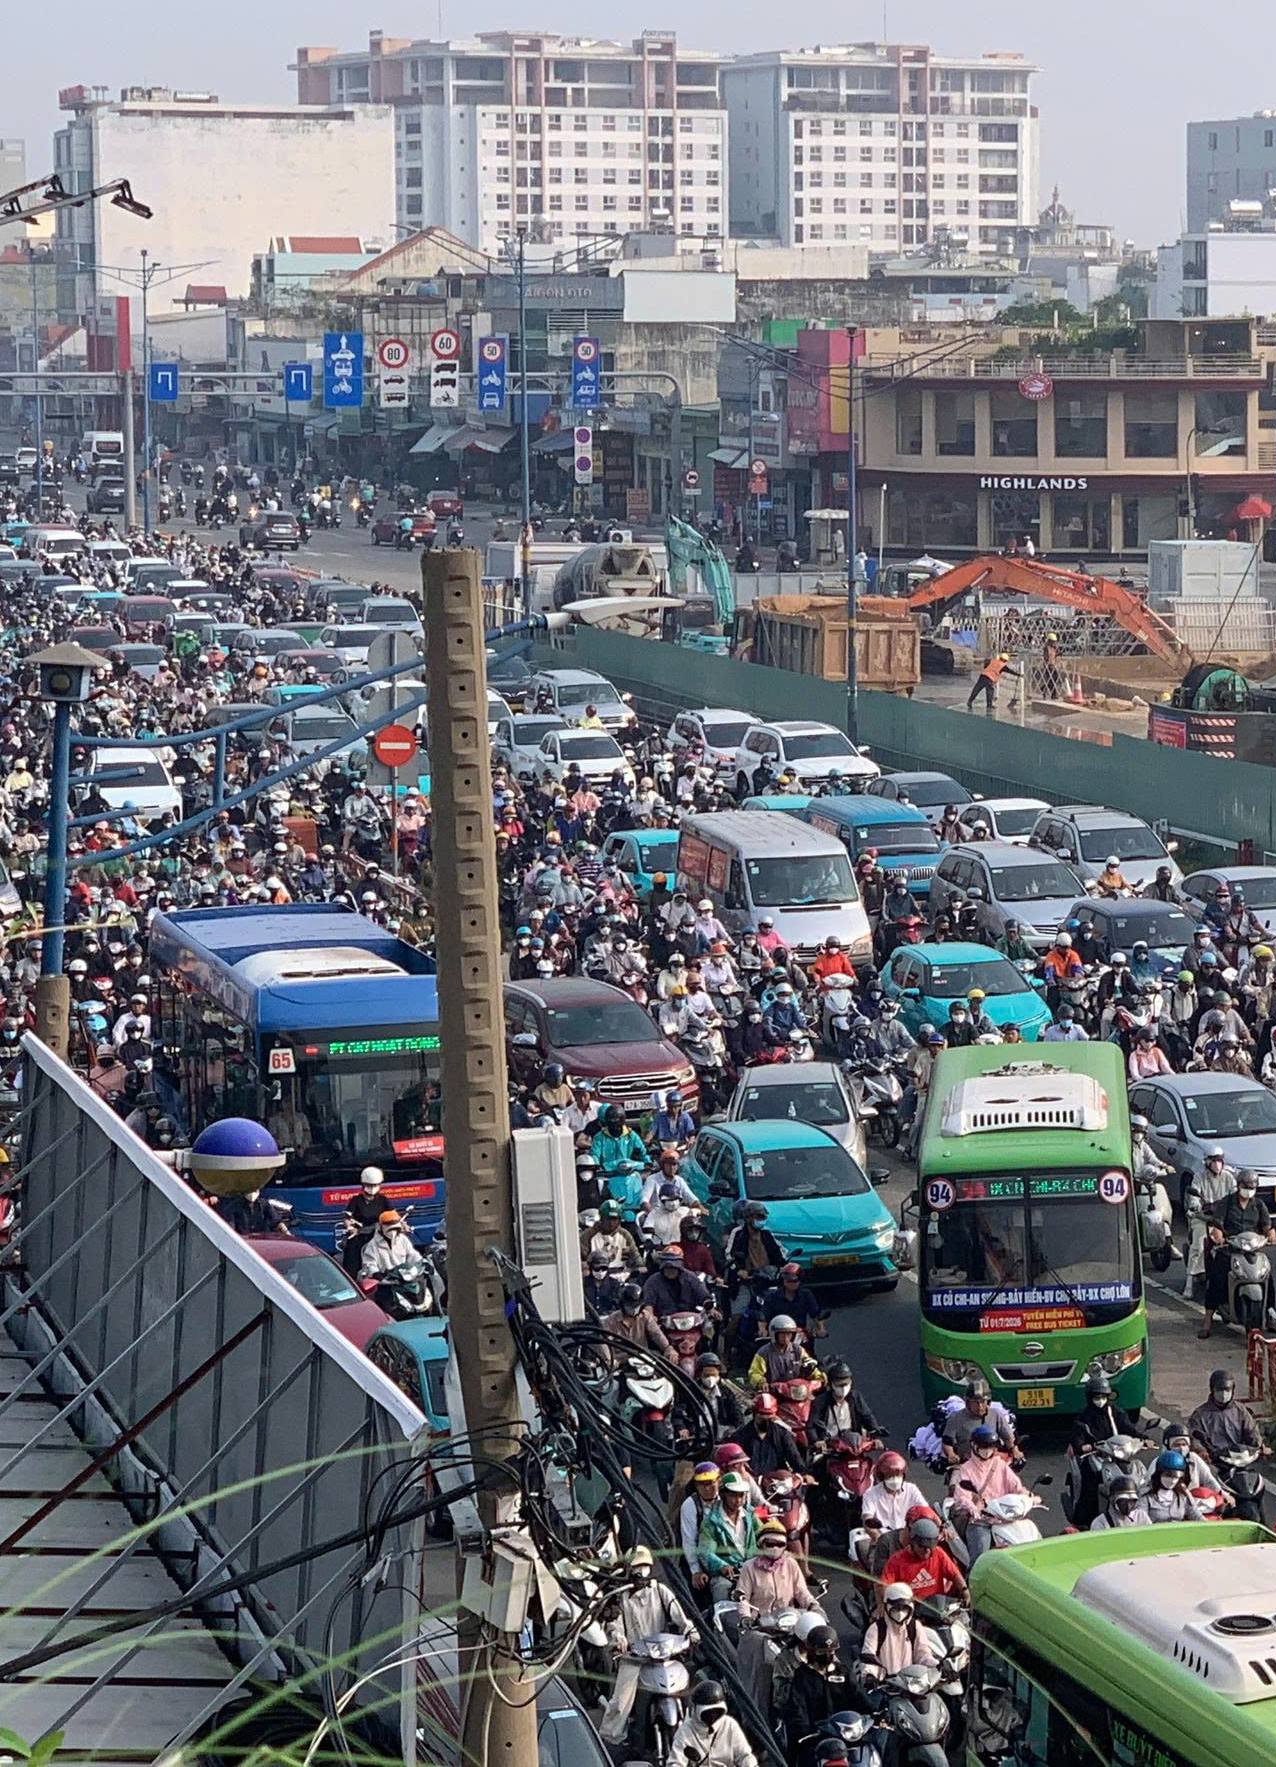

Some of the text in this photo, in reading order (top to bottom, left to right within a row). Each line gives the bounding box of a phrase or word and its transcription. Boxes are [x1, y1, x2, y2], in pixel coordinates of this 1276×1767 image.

[438, 338, 451, 350] 60
[387, 348, 400, 361] 80
[486, 346, 497, 356] 50
[581, 346, 592, 356] 50
[980, 477, 1088, 490] HIGHLANDS
[272, 1053, 291, 1069] 65
[930, 1181, 950, 1202] 94
[1104, 1178, 1125, 1197] 94
